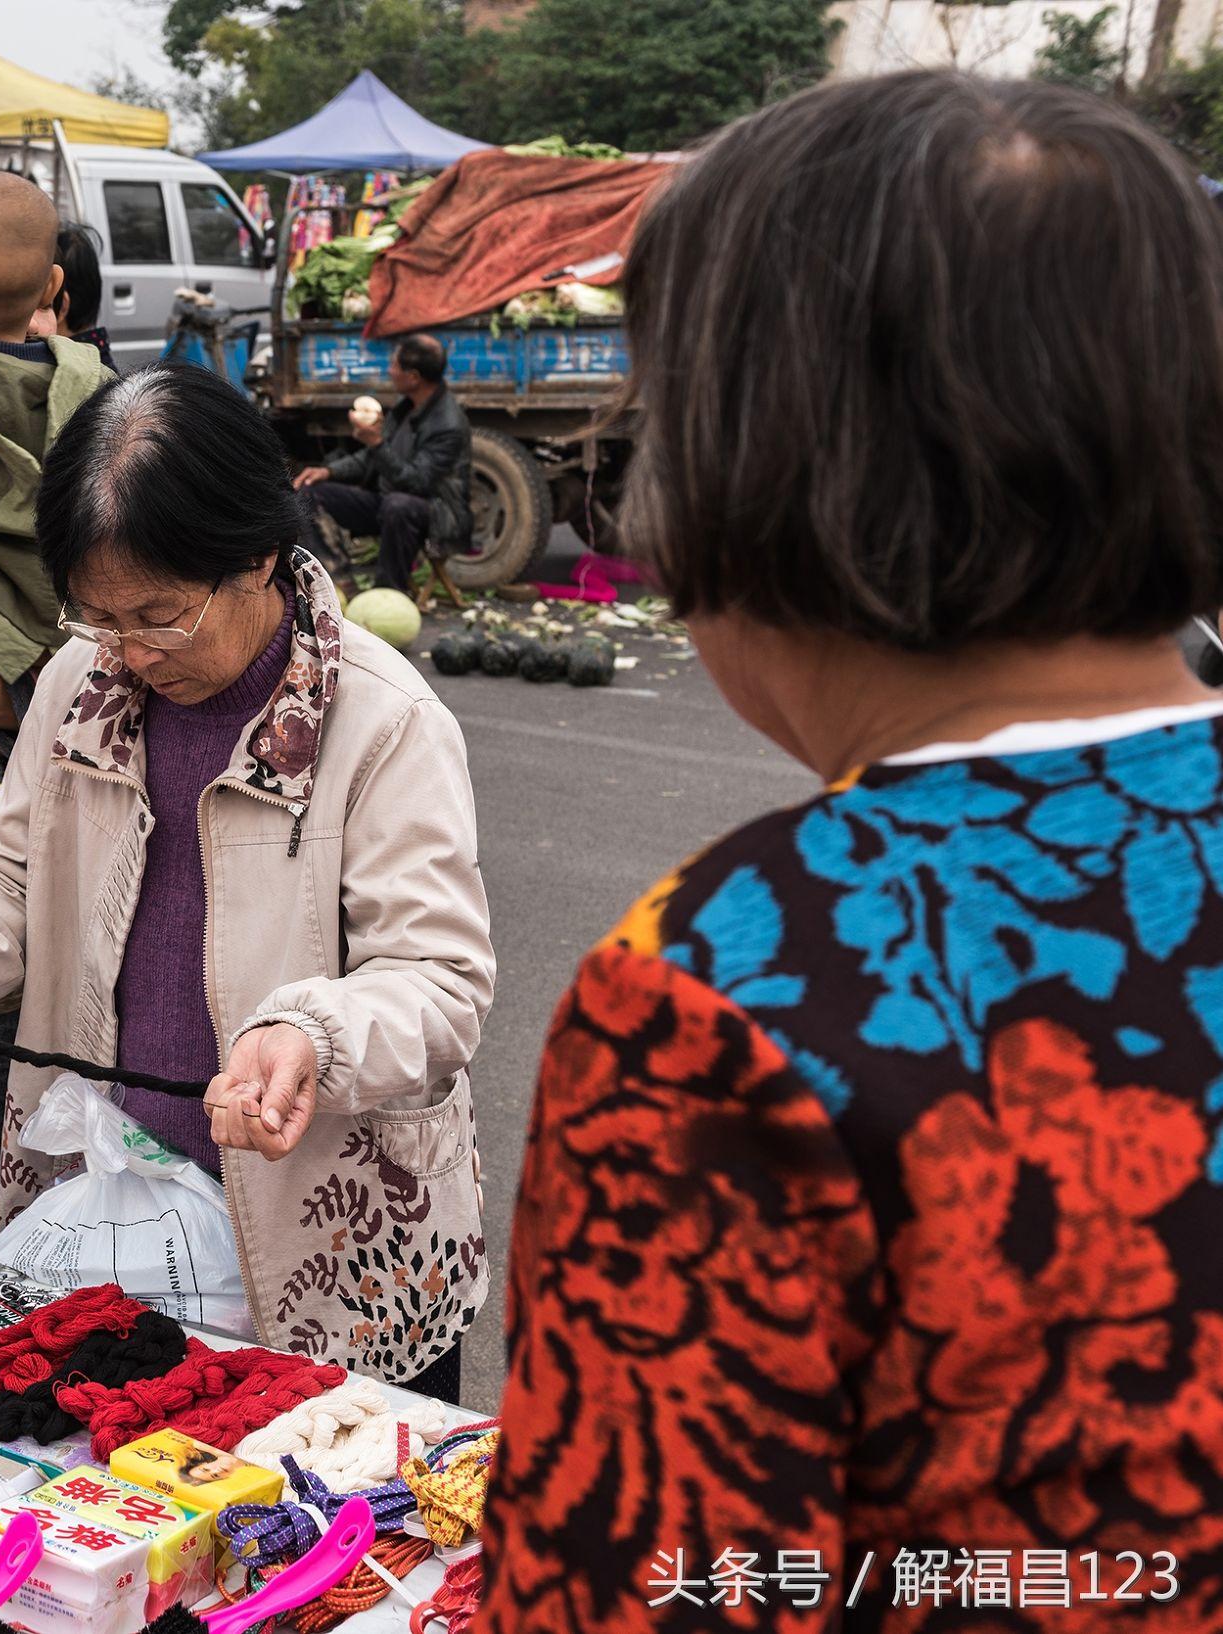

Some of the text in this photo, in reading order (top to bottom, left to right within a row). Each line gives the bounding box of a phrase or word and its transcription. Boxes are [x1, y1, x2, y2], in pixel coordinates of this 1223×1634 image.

[51, 1475, 178, 1526] 名猫
[179, 1536, 197, 1554] 名猫
[115, 1571, 134, 1590] 名猫
